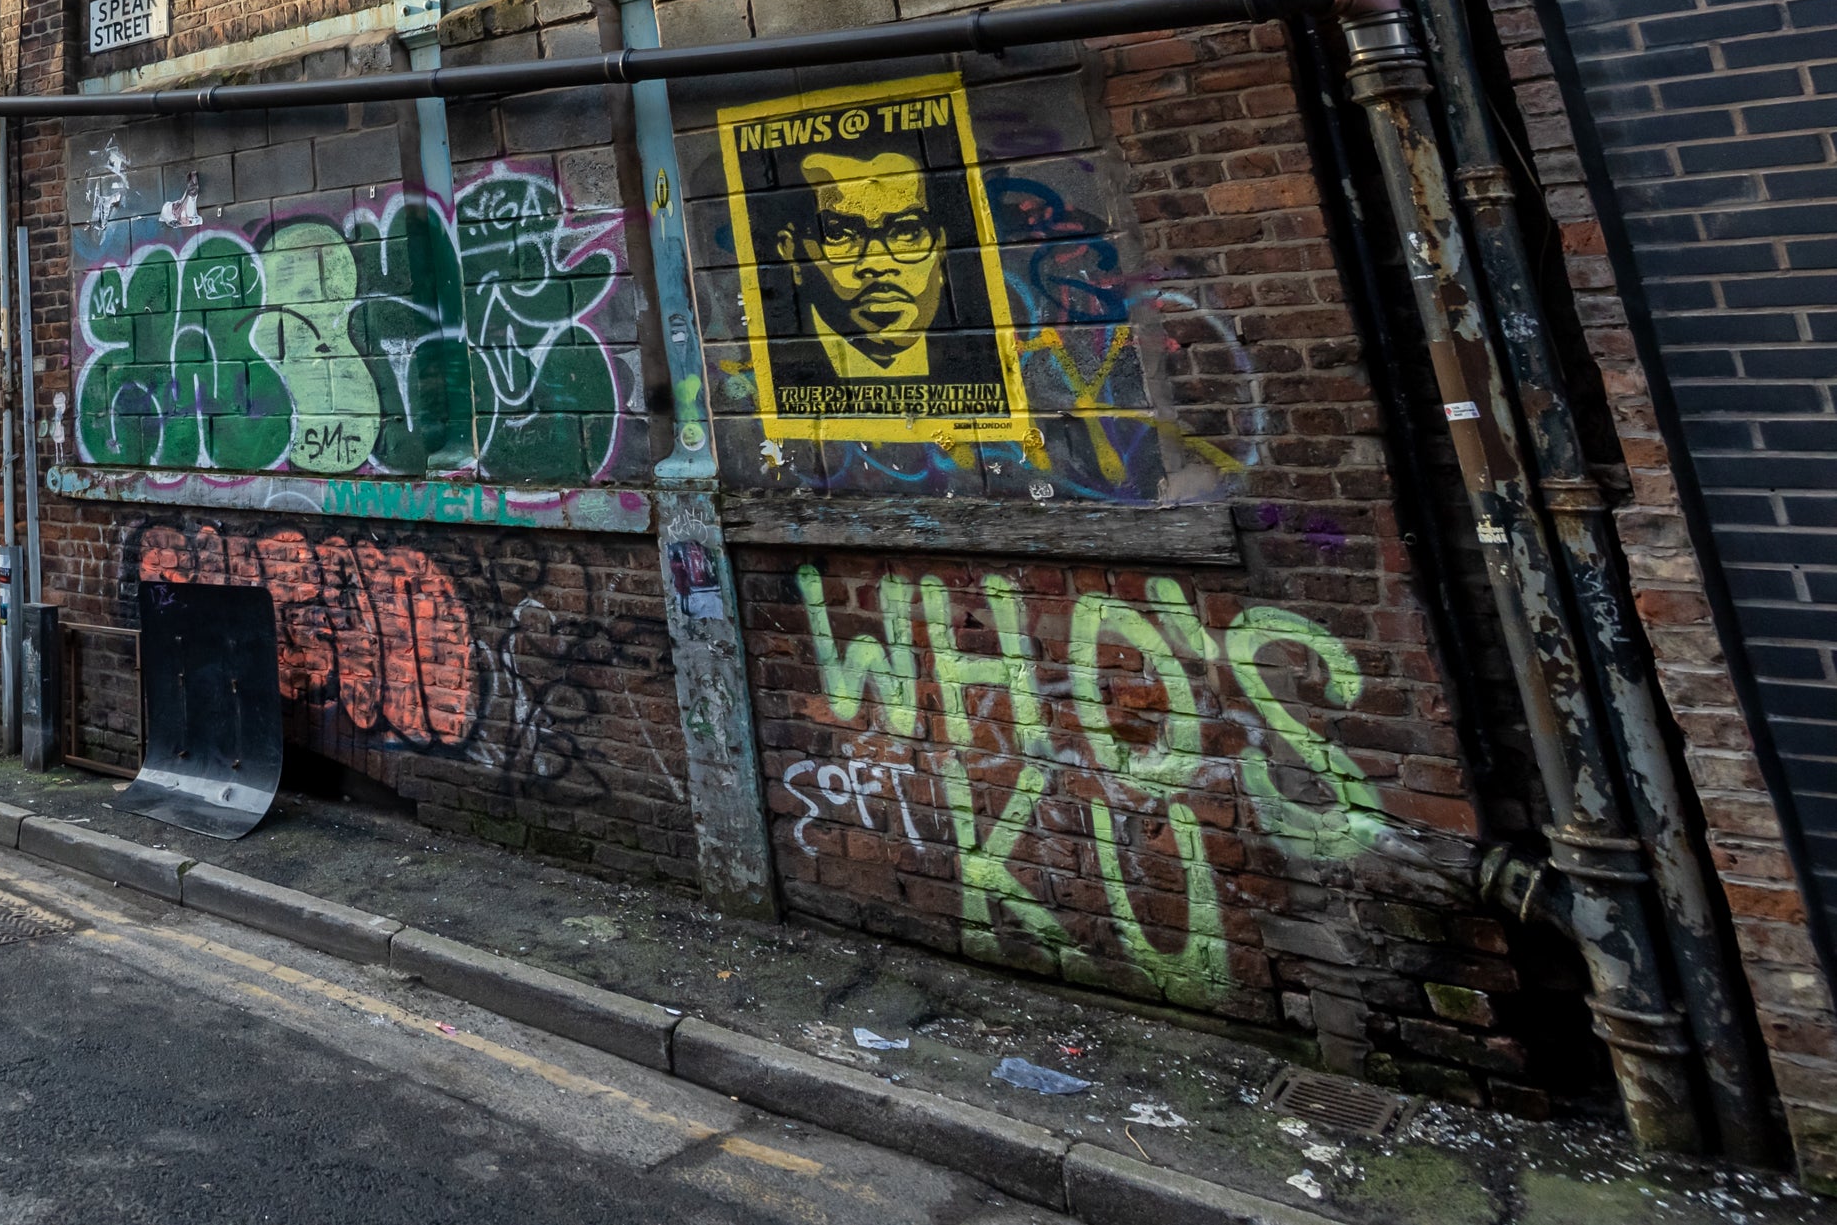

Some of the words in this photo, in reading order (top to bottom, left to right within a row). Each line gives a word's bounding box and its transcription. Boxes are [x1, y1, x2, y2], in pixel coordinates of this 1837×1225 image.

[94, 12, 153, 48] STREET
[739, 114, 832, 153] NEWS
[837, 109, 870, 140] @
[877, 97, 950, 133] TEN
[778, 386, 823, 403] TRUE
[824, 385, 888, 403] POWER
[888, 384, 928, 401] LIES
[928, 383, 1001, 400] WITHIN
[780, 402, 811, 415] AND
[811, 402, 825, 414] IS
[825, 401, 903, 415] AVAILABLE
[903, 401, 928, 414] TO
[928, 401, 963, 414] YOU
[783, 759, 926, 856] SOFT
